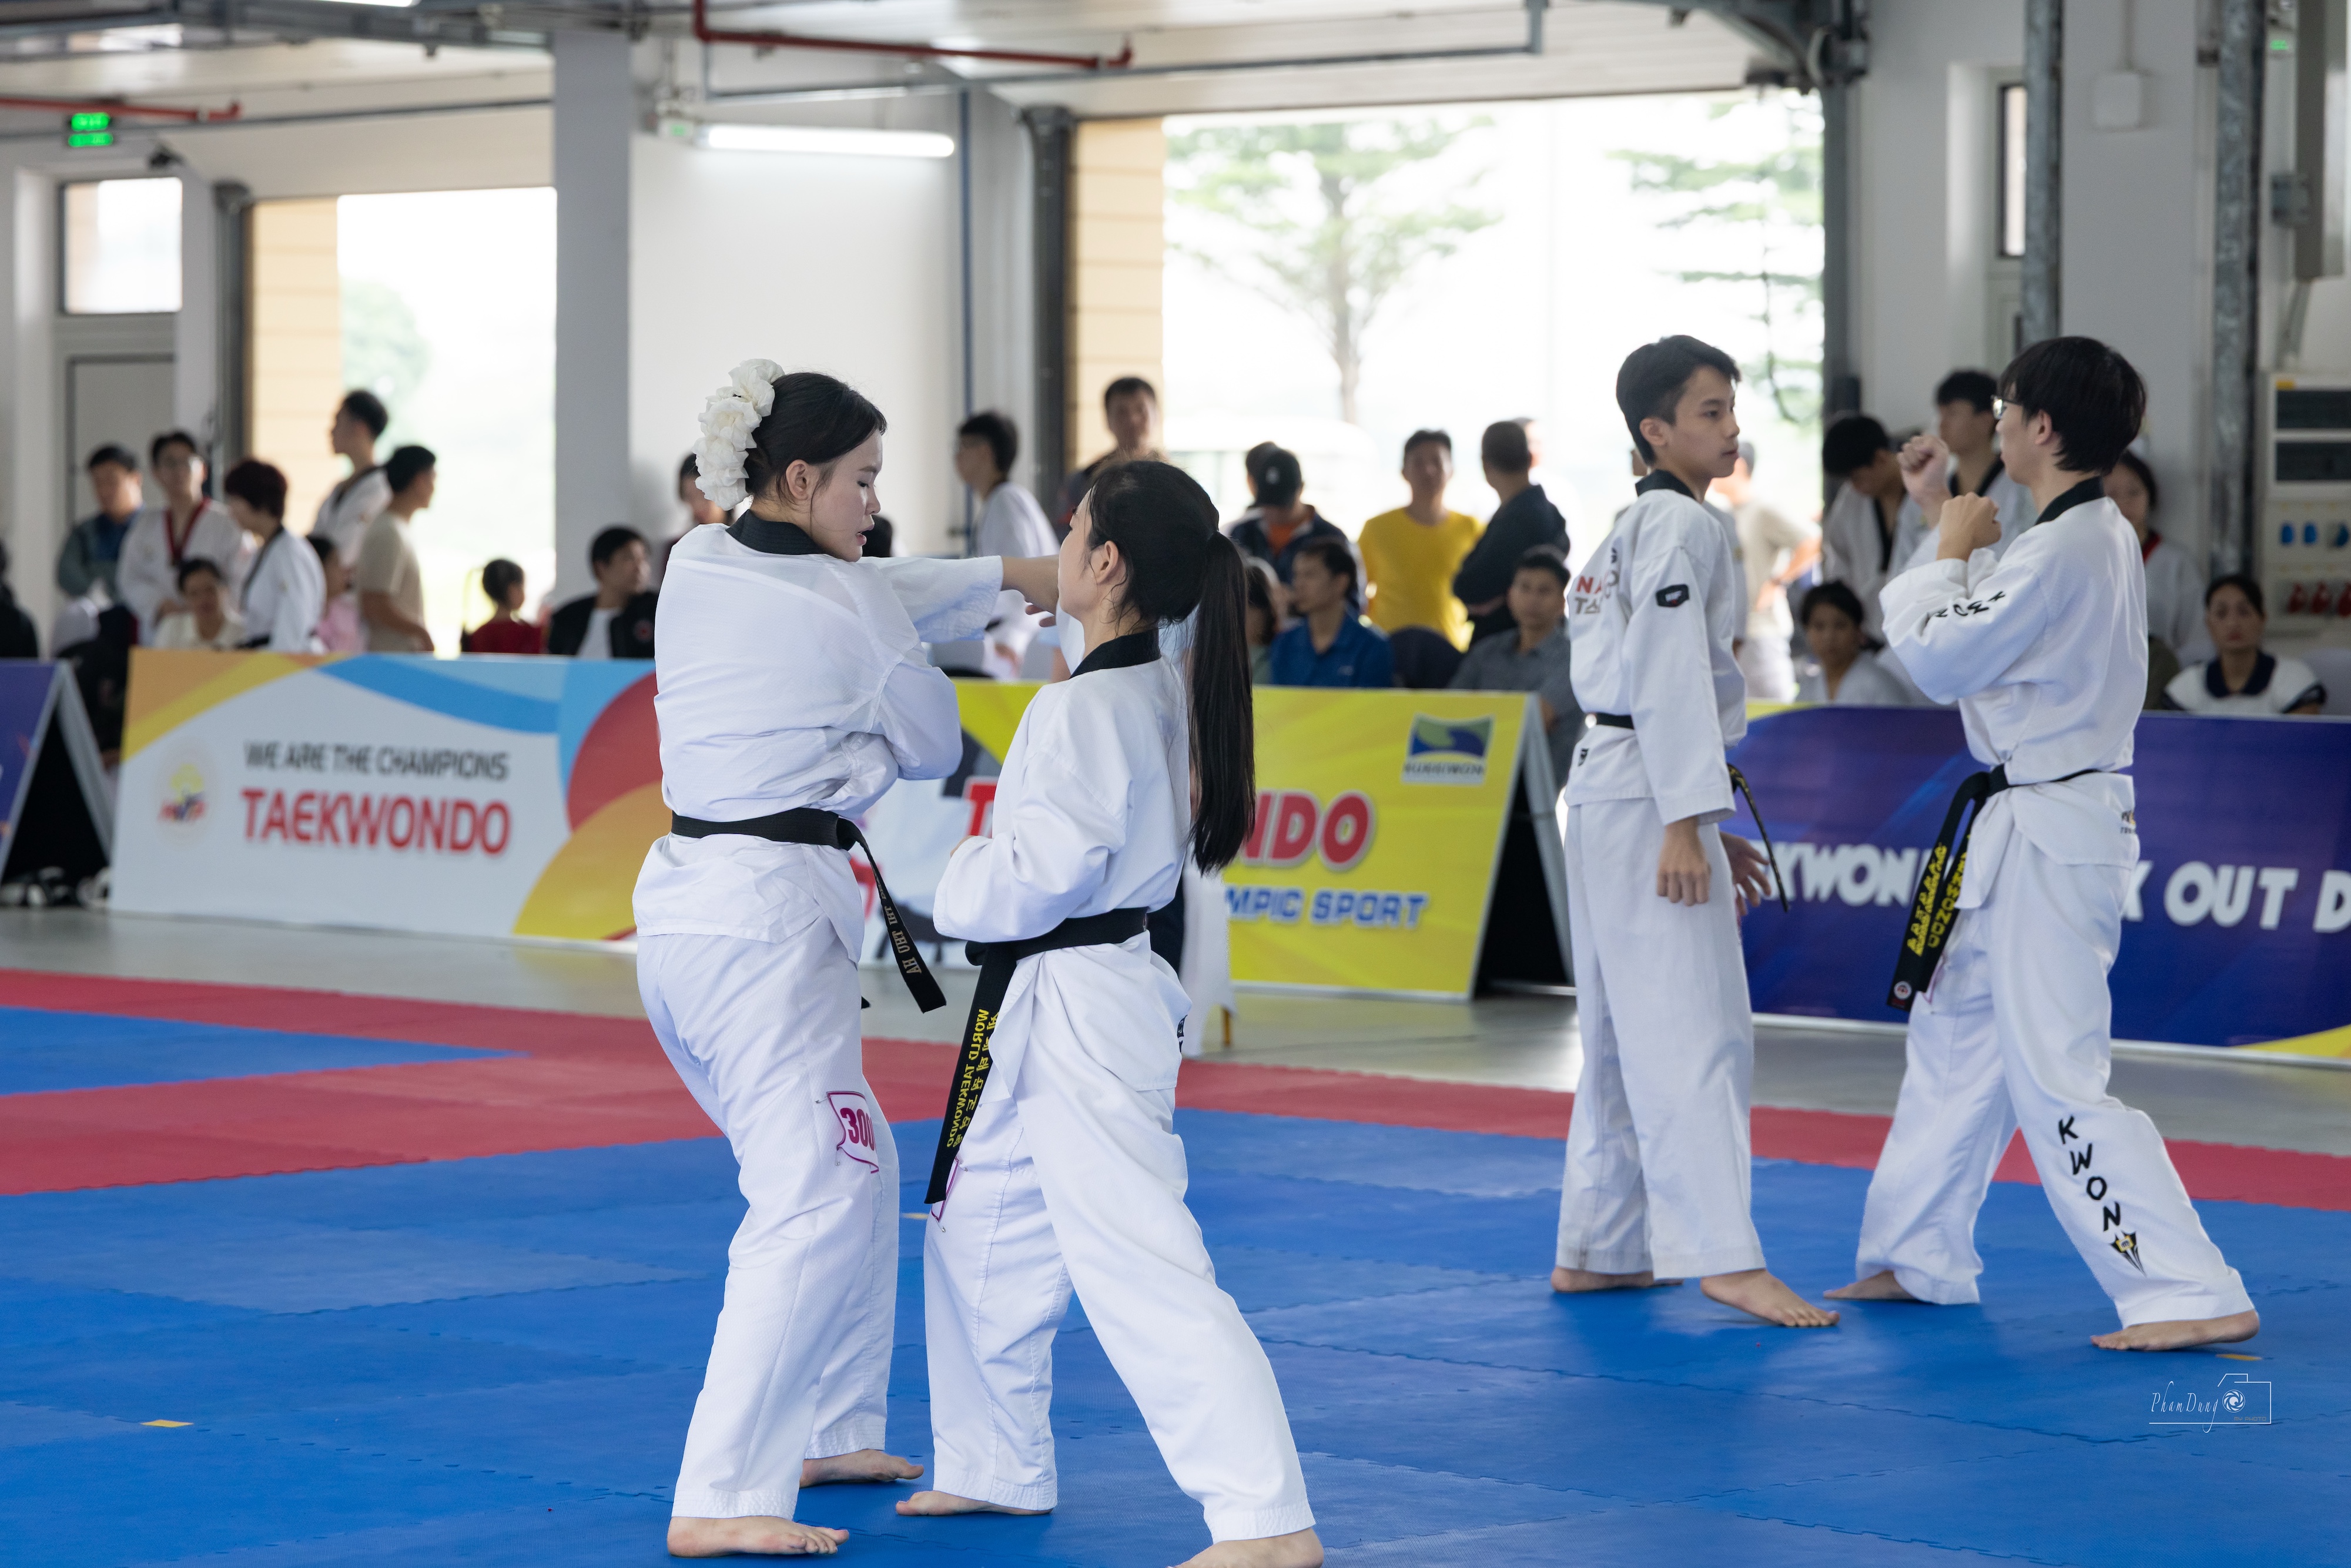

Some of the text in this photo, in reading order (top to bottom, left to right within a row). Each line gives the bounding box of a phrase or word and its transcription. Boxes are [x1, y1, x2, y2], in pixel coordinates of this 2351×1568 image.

[244, 742, 510, 780] WE ARE THE CHAMPIONS
[242, 789, 511, 855] TAEKWONDO
[1226, 888, 1425, 928] MPIC SPORT
[2164, 861, 2299, 930] OUT
[2058, 1115, 2121, 1232] KWON
